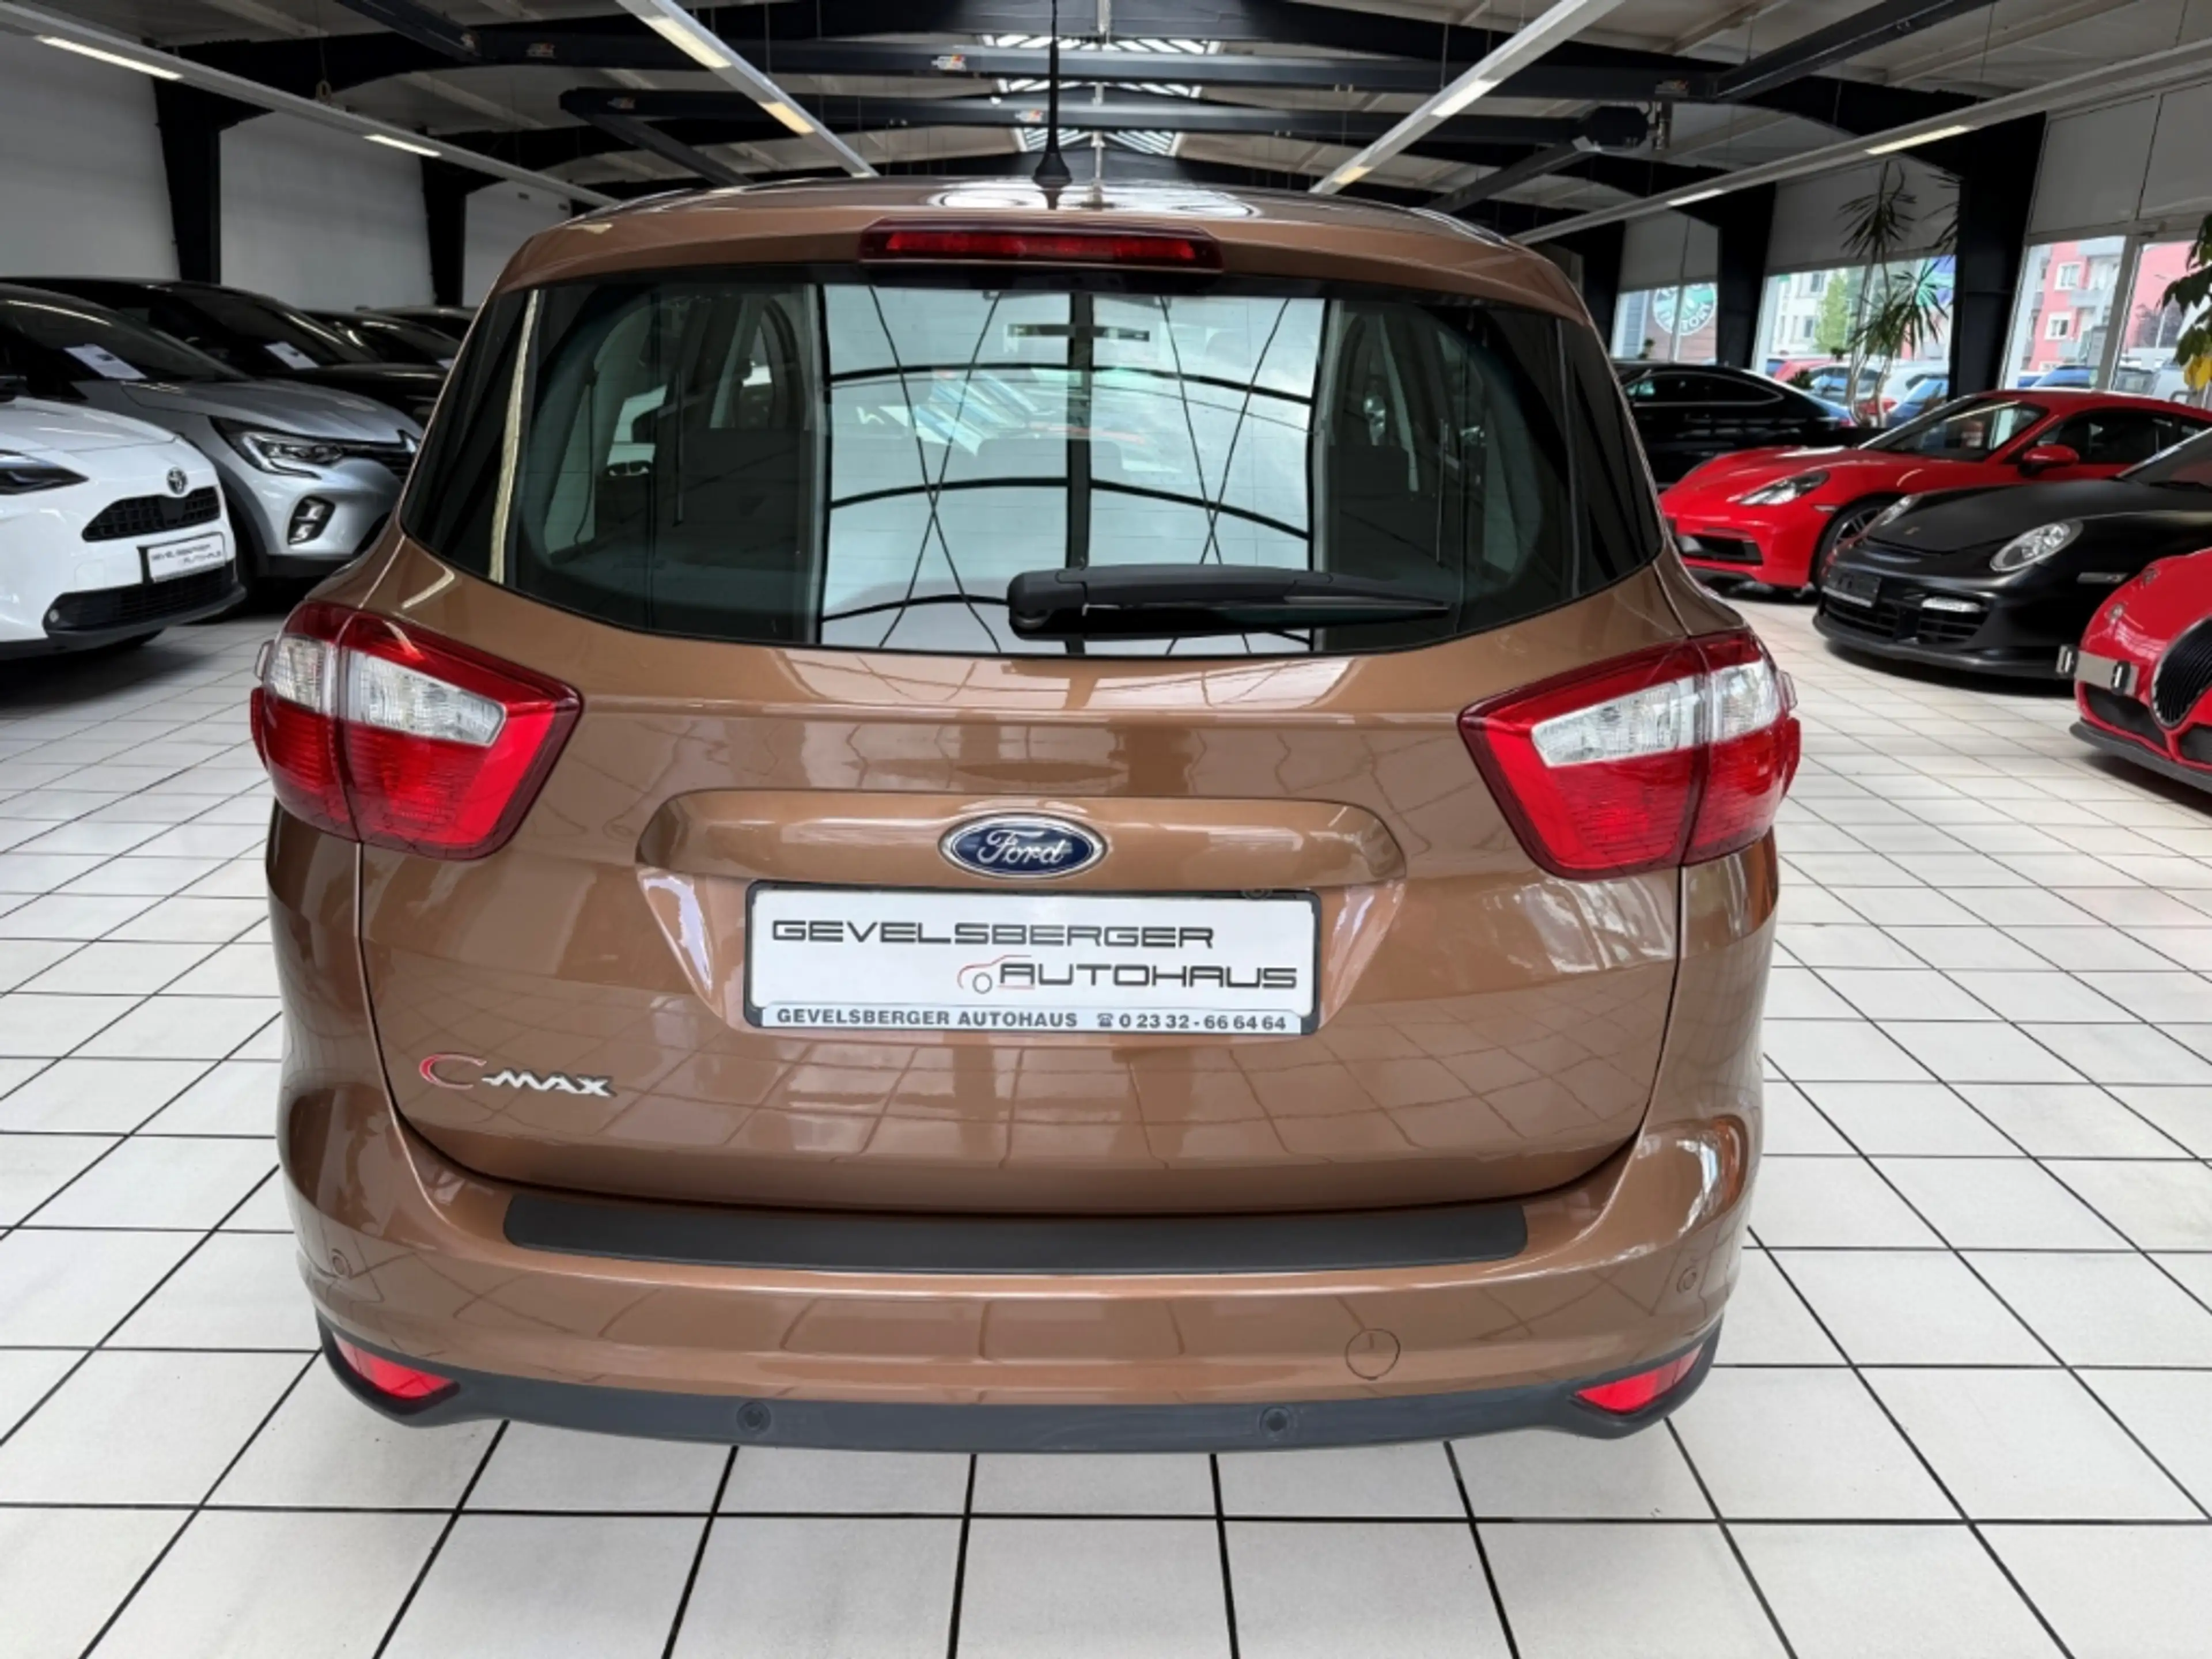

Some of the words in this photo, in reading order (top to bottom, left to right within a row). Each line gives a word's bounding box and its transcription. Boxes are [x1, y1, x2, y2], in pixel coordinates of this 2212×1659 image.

[977, 830, 1066, 864] Ford
[772, 920, 1213, 949] GEVELSBERGER
[999, 963, 1297, 988] AUTOHAUS
[777, 1009, 950, 1025] GEVELSBERGER
[959, 1012, 1078, 1028] AUTOHAUS
[419, 1053, 616, 1097] C-MAX
